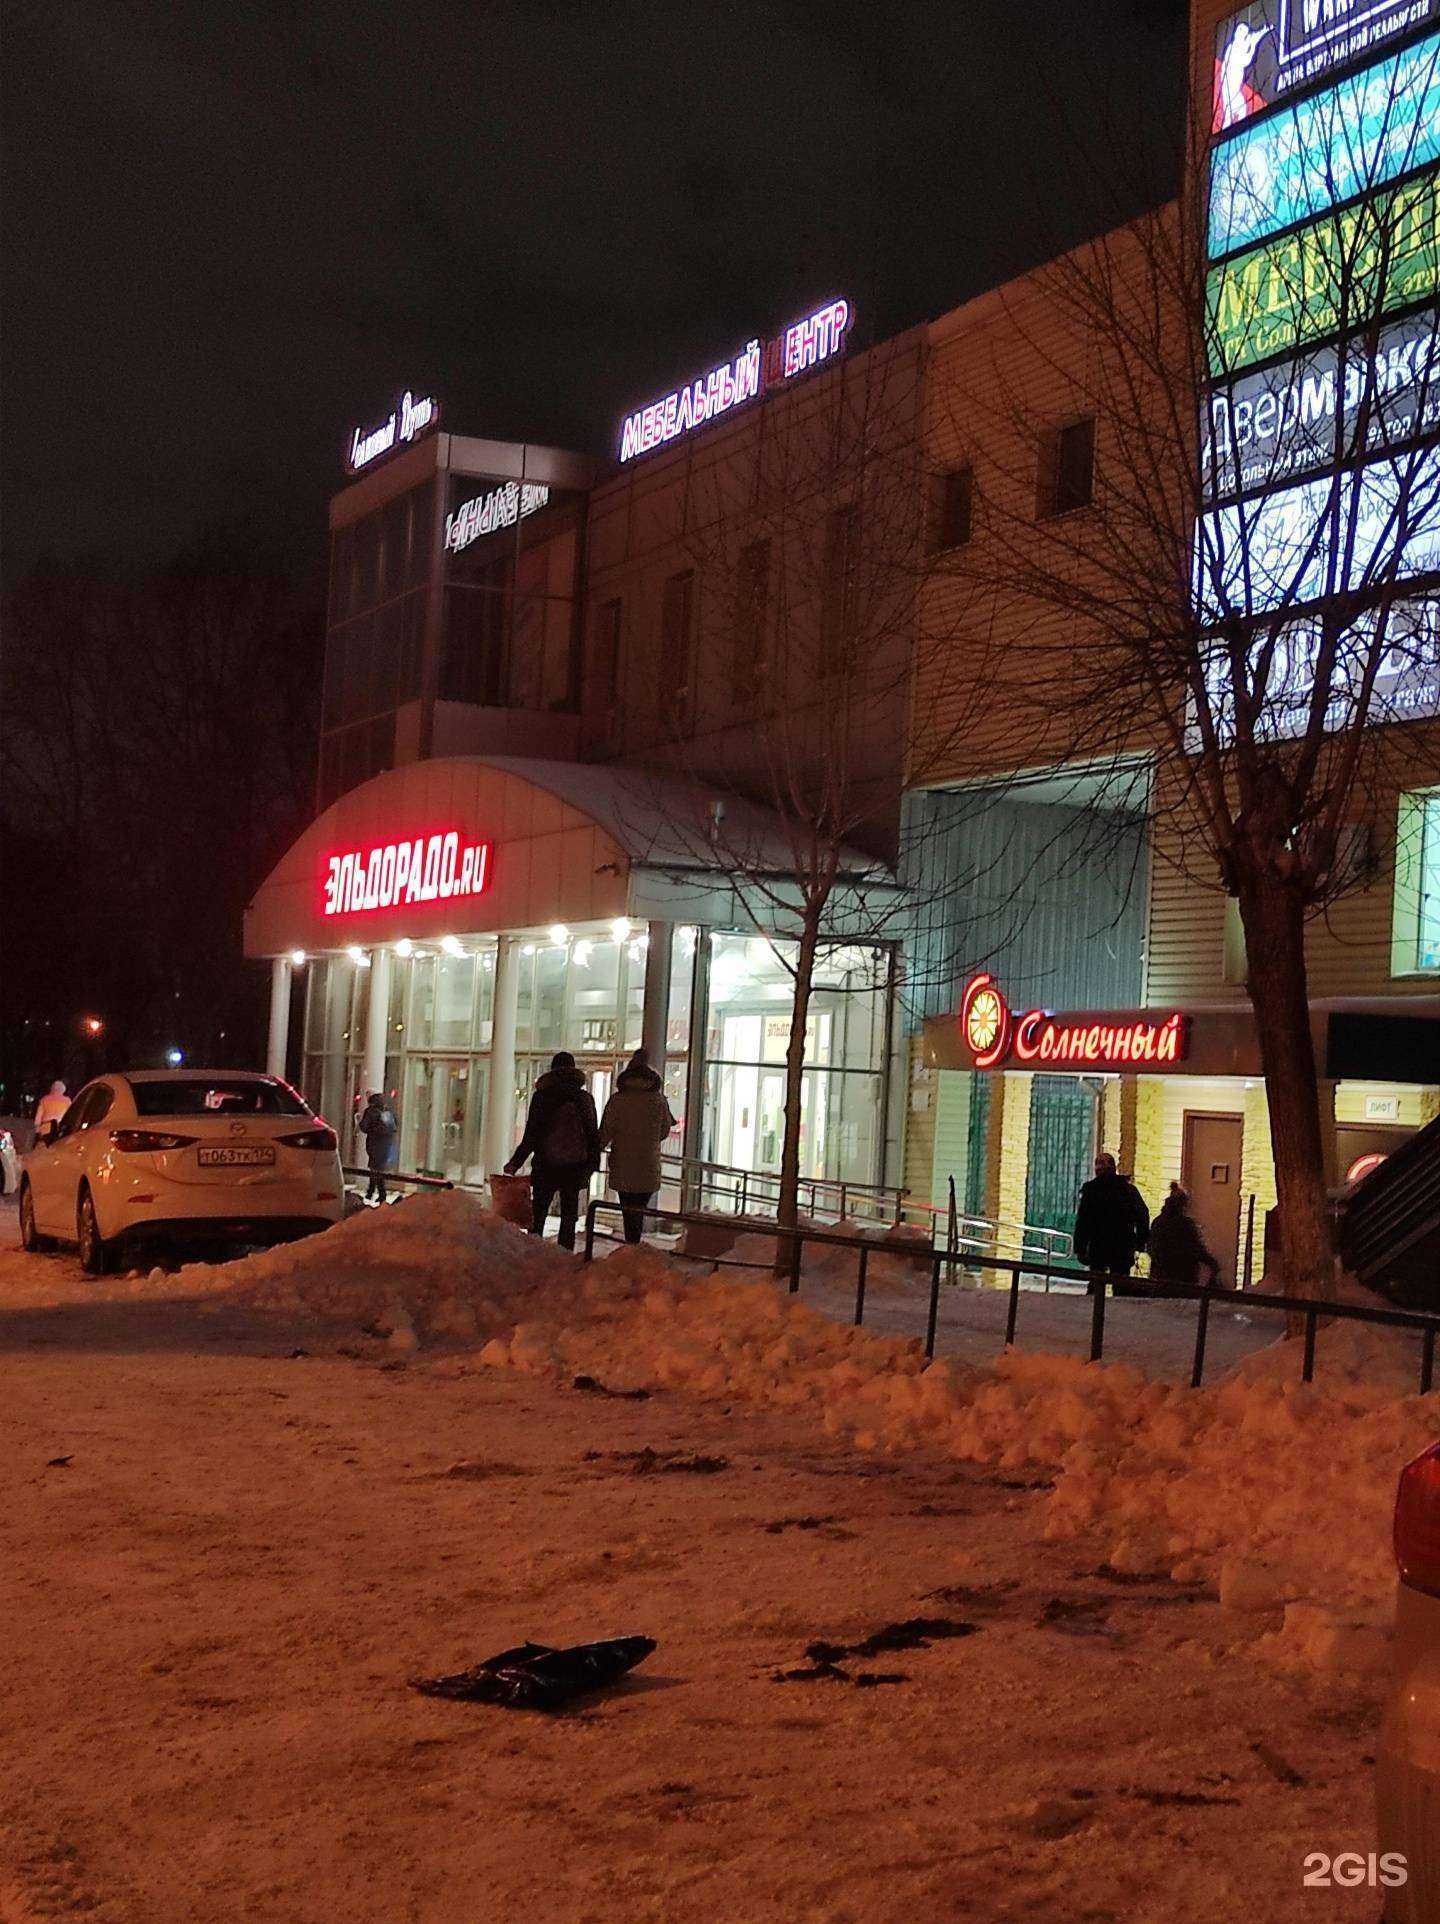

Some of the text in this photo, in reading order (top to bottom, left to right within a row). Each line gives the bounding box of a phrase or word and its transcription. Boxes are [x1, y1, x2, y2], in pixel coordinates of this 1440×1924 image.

[621, 339, 760, 463] МЕБЕЛЬНЫЙ
[324, 831, 488, 915] ЭЛЬДОРАДО.RU
[1017, 1010, 1180, 1061] Солнечный
